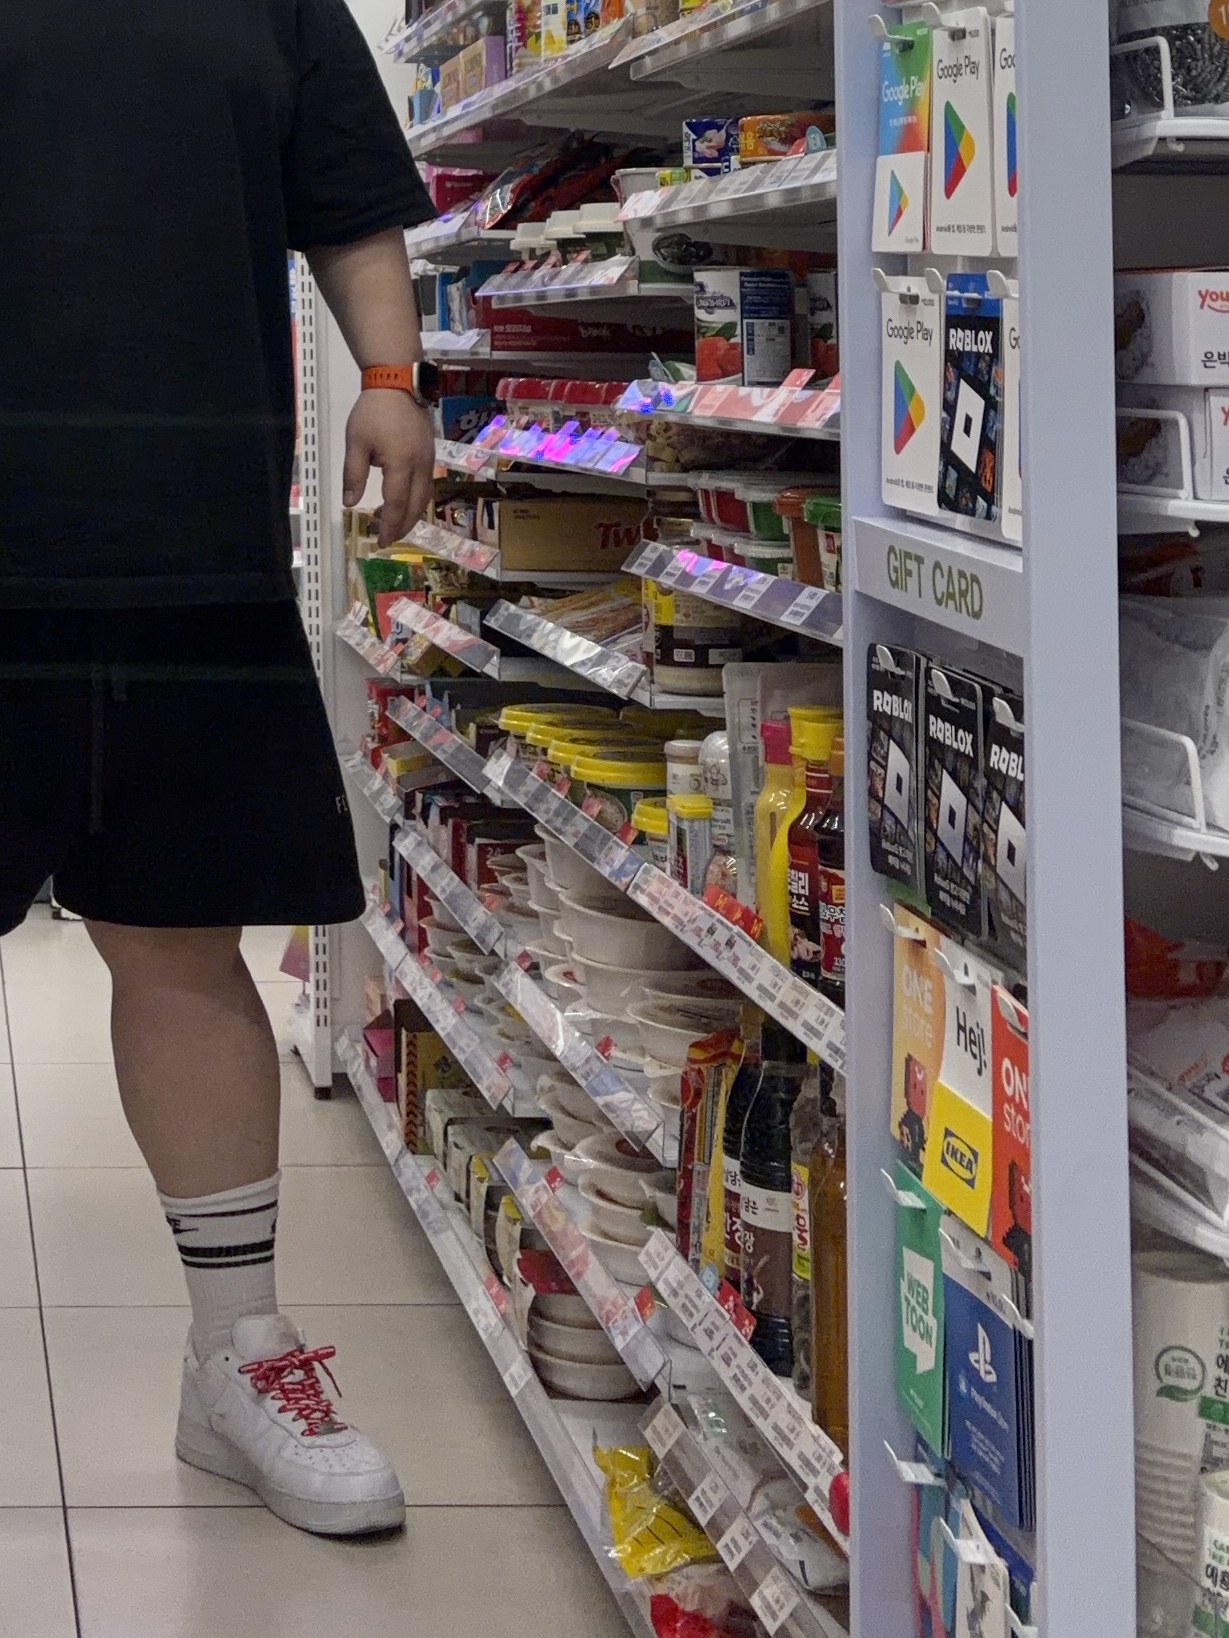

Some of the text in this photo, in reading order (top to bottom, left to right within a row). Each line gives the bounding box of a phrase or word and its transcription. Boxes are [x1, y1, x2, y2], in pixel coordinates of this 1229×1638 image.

[937, 54, 980, 84] Google Play
[886, 318, 934, 348] Google Play
[949, 326, 993, 354] ROBLOX
[886, 544, 984, 622] GIFT CARD
[873, 688, 913, 724] ROBLOX
[929, 713, 974, 759] ROBLOX
[956, 1005, 988, 1078] Hej!
[945, 1138, 975, 1175] IKEA
[905, 1268, 930, 1312] WEB
[903, 1294, 933, 1349] TOON
